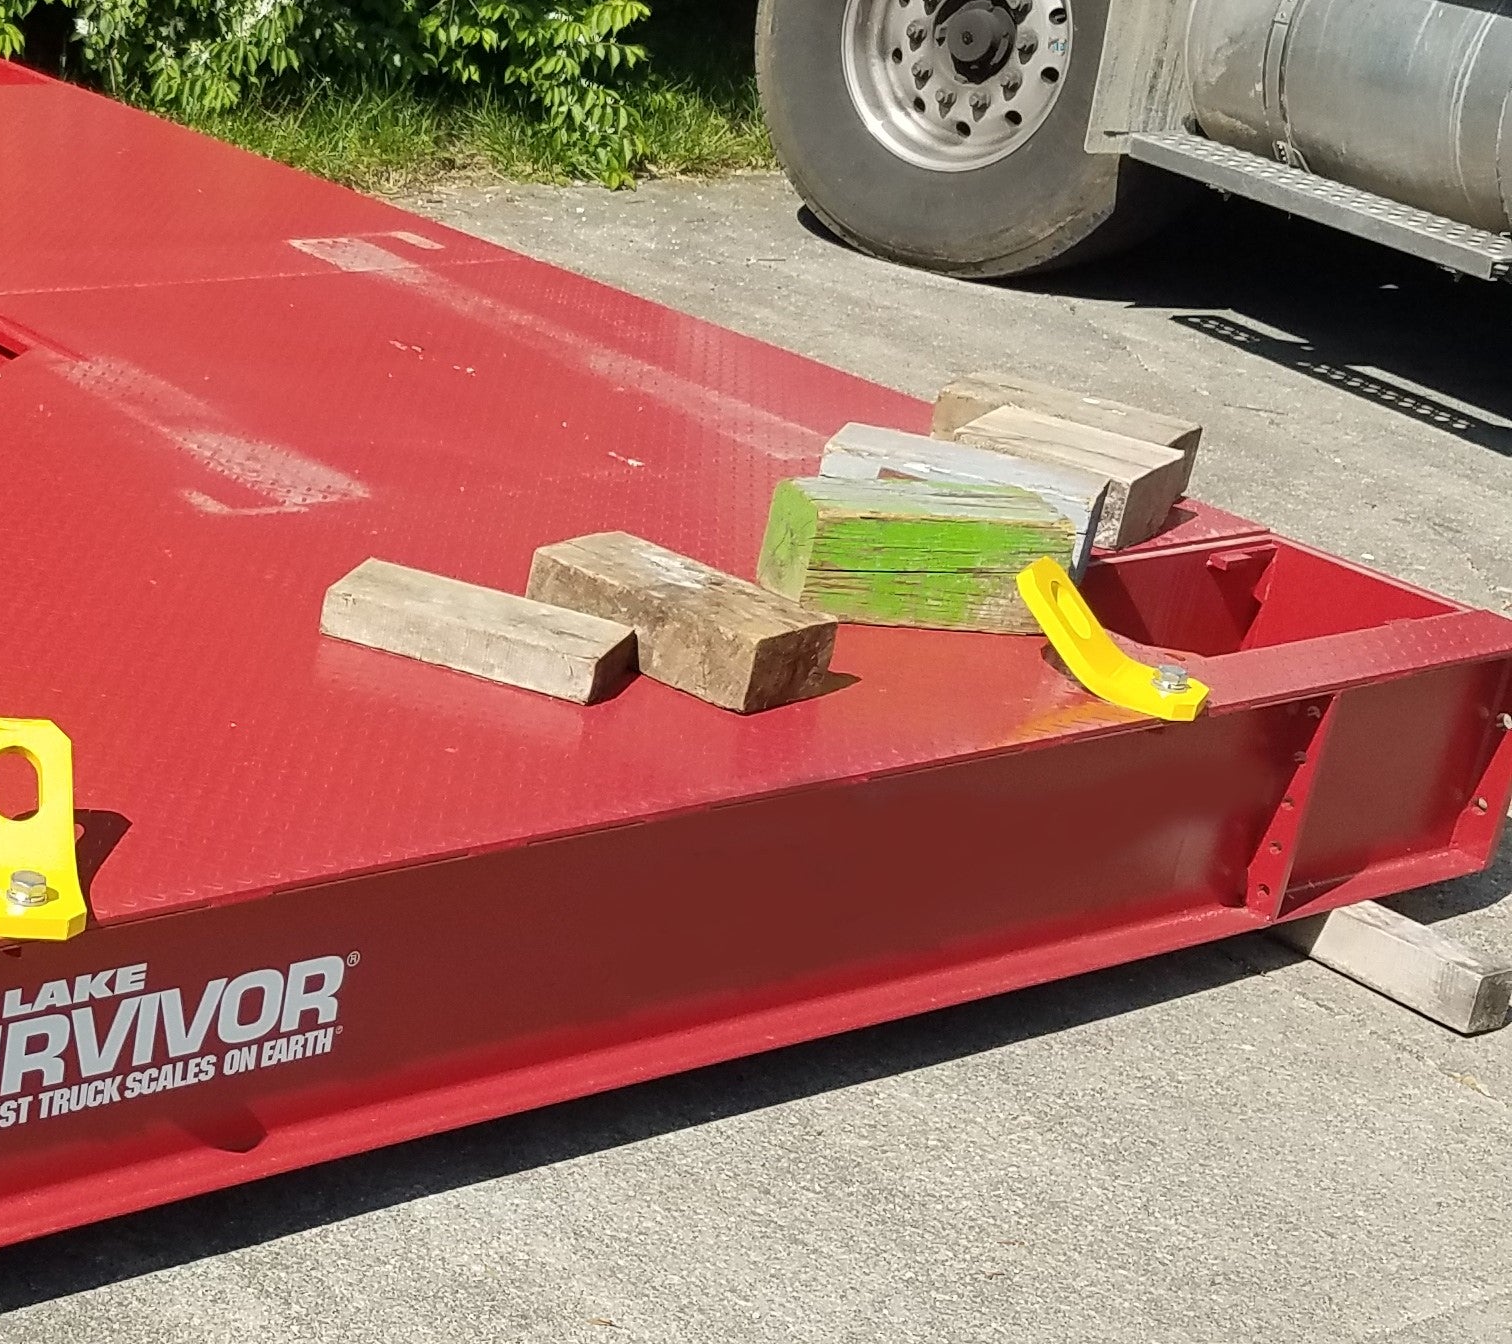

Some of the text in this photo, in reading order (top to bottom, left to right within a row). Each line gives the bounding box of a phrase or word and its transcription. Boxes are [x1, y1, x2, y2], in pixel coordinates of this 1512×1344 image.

[2, 962, 148, 1018] LAKE
[37, 1075, 122, 1120] TRUCK
[124, 1052, 216, 1101] SCALES
[222, 1042, 256, 1077] ON
[260, 1025, 335, 1069] EARTH
